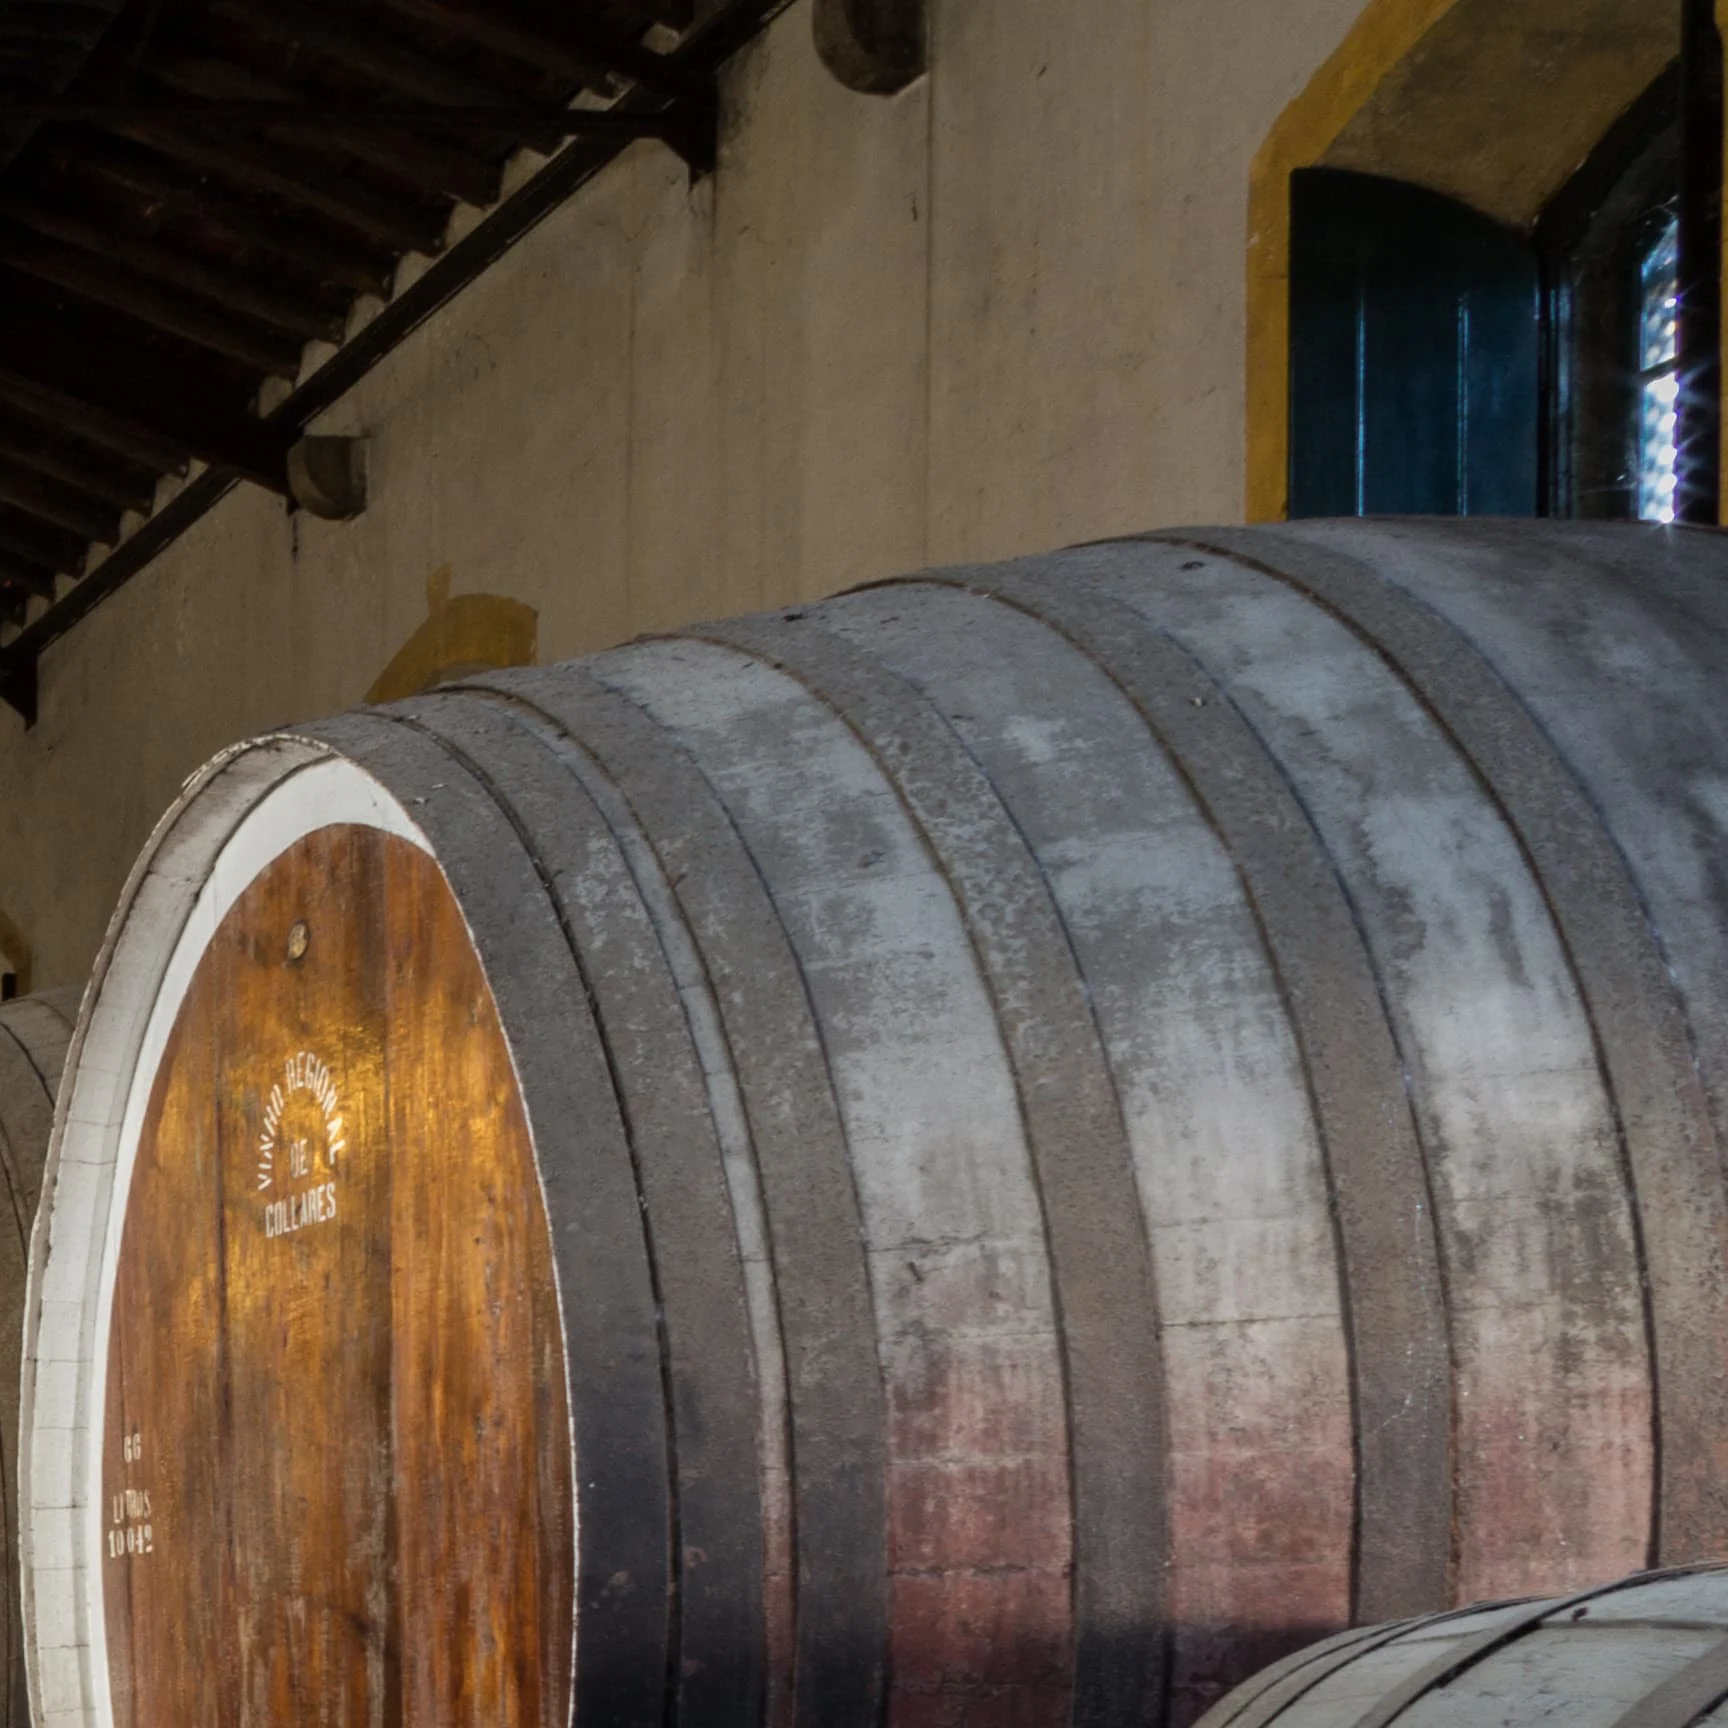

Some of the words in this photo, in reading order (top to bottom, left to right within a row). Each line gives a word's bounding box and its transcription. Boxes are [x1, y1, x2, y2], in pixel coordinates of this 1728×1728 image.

[258, 1084, 284, 1190] VINHO
[285, 1051, 346, 1165] REGIONAL
[290, 1138, 308, 1179] DE
[264, 1182, 337, 1239] COLLARES
